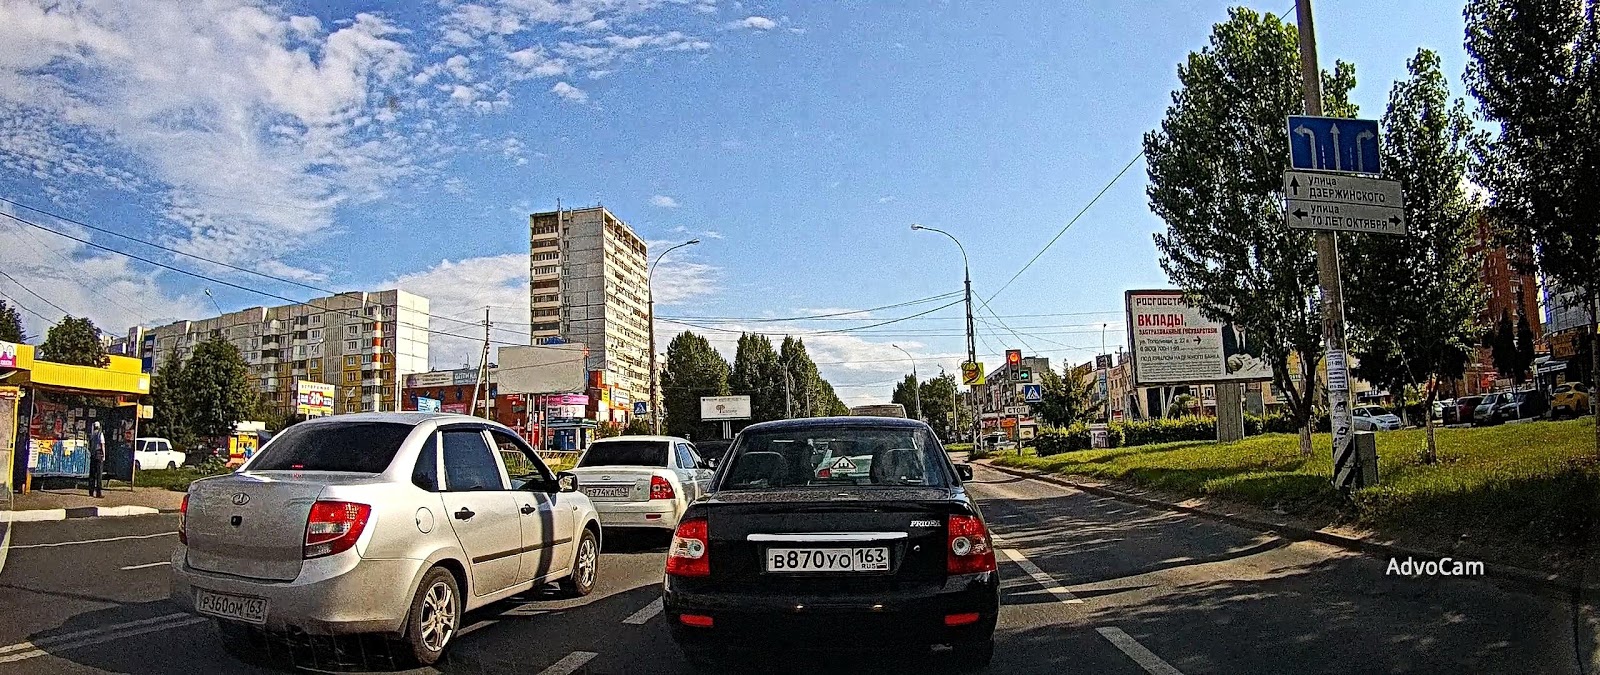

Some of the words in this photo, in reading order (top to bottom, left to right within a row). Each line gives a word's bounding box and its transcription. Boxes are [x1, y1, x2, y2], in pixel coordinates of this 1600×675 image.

[1308, 176, 1337, 186] улица
[1309, 187, 1386, 203] ДЗЕРЖИНСКОГО
[1310, 204, 1340, 215] улица
[1311, 215, 1323, 226] 70
[1324, 216, 1343, 227] ЛЕТ
[1346, 217, 1388, 231] ОКТЯБРЯ
[1137, 313, 1187, 327] ВКЛАДЫ,
[774, 550, 851, 569] В870УО
[854, 548, 884, 564] 163
[202, 595, 243, 616] Р360ОМ
[246, 599, 262, 614] 163
